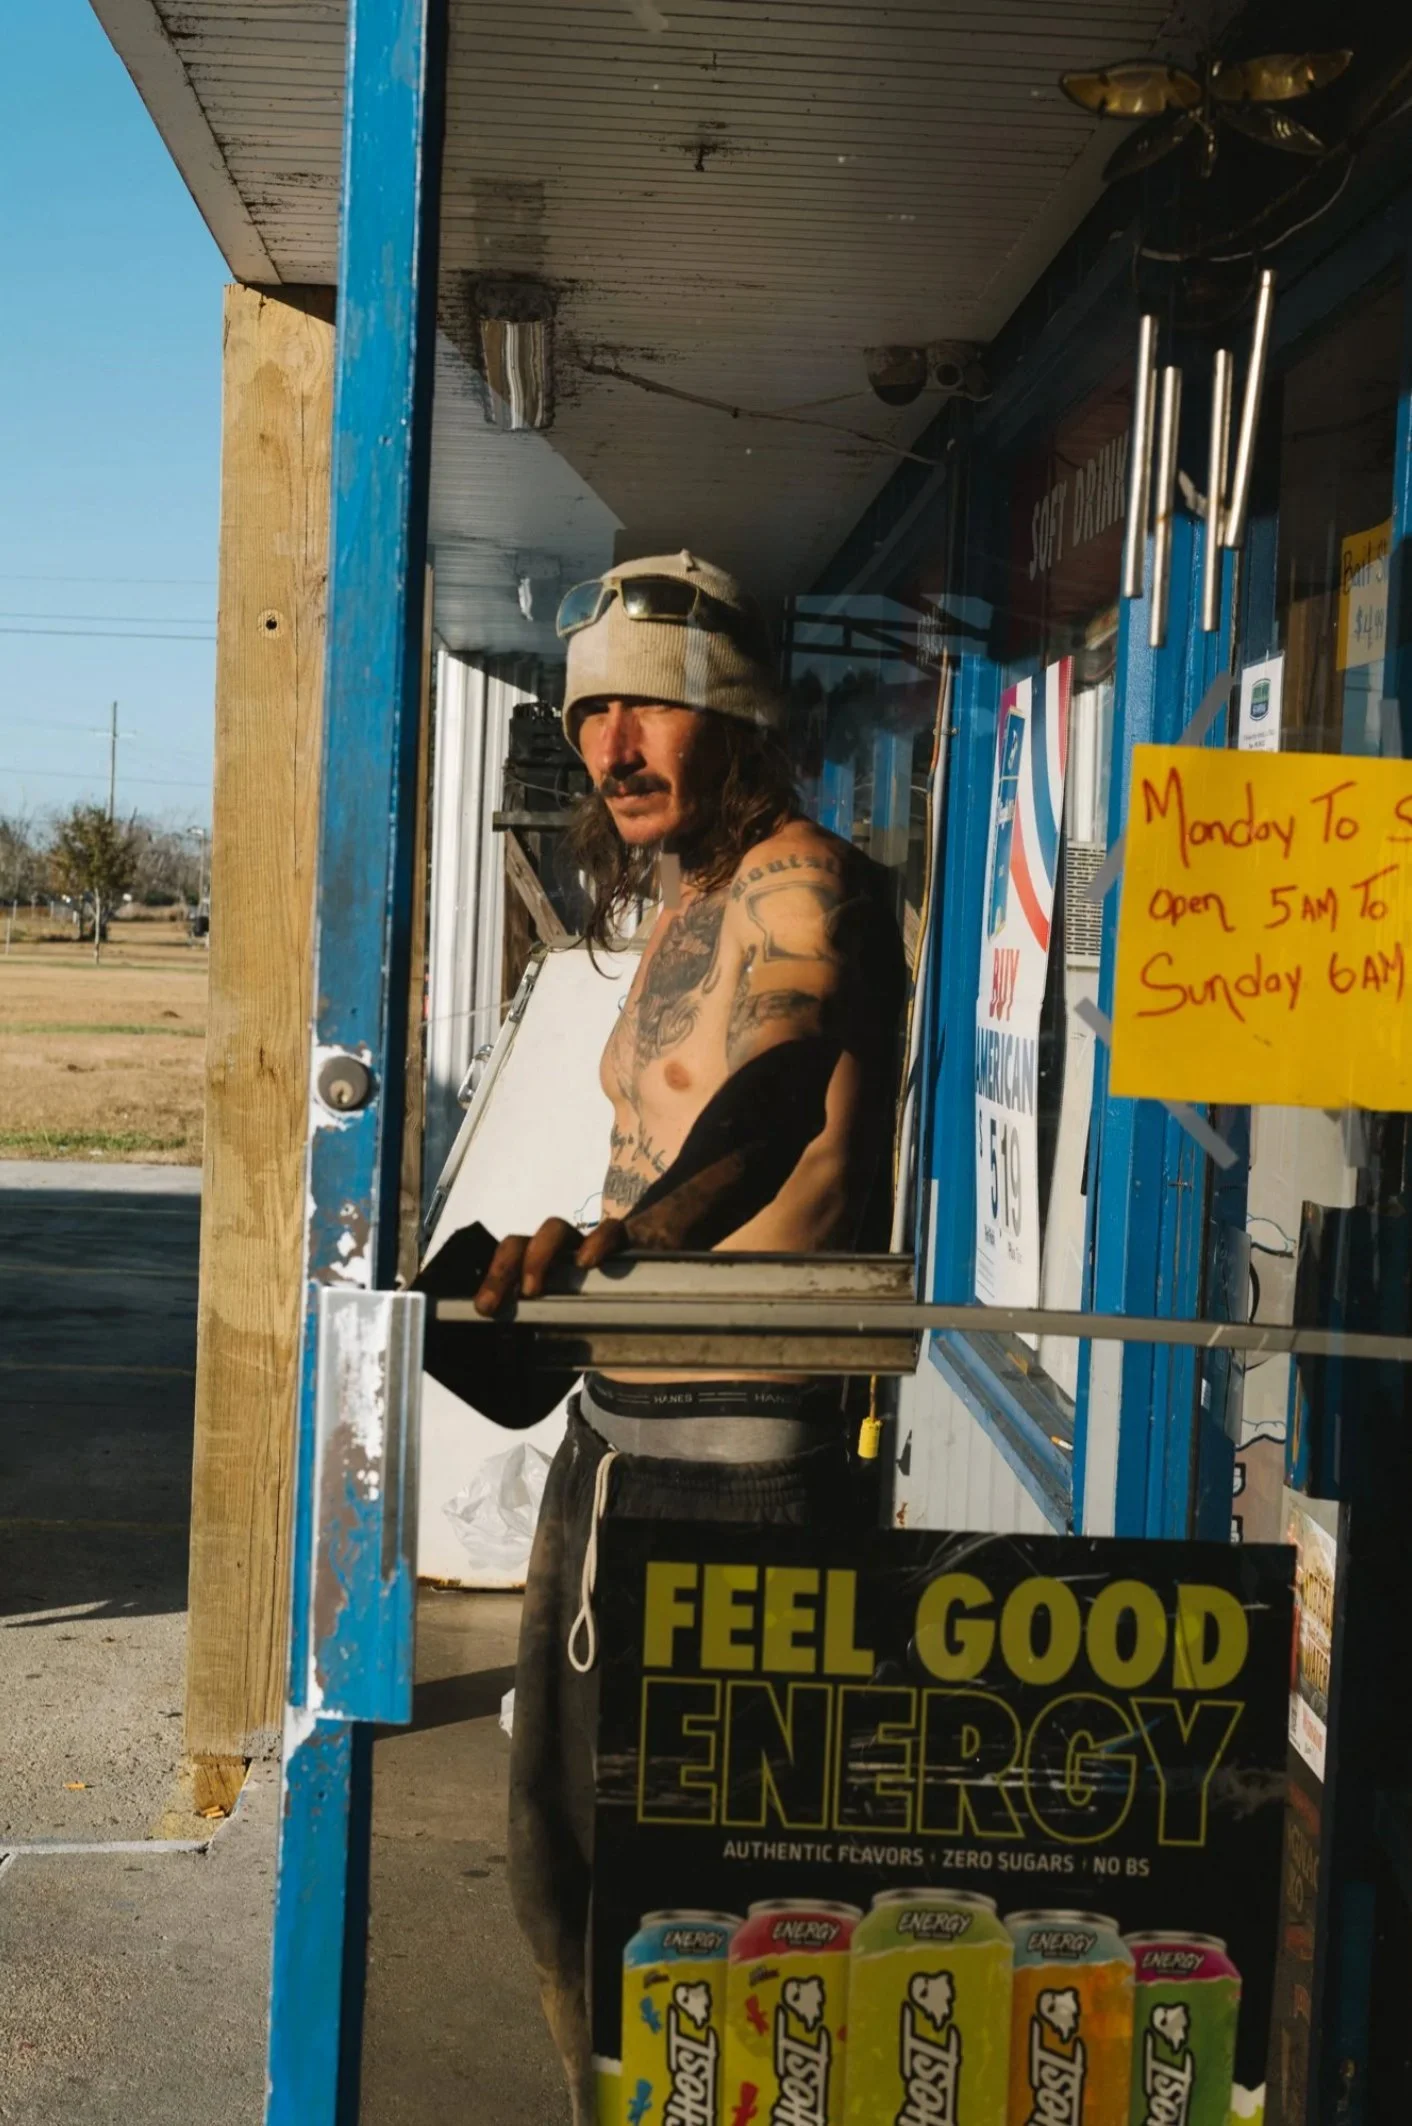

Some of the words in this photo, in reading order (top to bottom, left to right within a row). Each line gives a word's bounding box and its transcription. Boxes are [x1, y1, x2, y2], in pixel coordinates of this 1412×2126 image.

[1029, 479, 1067, 581] SOFT
[1142, 766, 1296, 868] Monday
[1311, 781, 1359, 843] To
[1386, 793, 1412, 843] S
[1350, 864, 1400, 921] To
[989, 947, 1021, 1021] BUY
[1135, 951, 1302, 1024] Sunday
[976, 1025, 1035, 1117] AMERICAN
[643, 1561, 875, 1676] FEEL
[915, 1572, 1250, 1691] GOOD
[637, 1676, 1245, 1847] ENERGY
[723, 1840, 833, 1863] AUTHENTIC
[837, 1846, 924, 1867] FLAVORS
[942, 1849, 993, 1870] ZERO
[997, 1851, 1075, 1873] SUGARS
[1093, 1855, 1120, 1875] NO
[1125, 1856, 1151, 1877] BS
[664, 1930, 723, 1949] ENERGY
[773, 1920, 840, 1941] ENERGY
[898, 1911, 971, 1934] ENERGY
[1027, 1931, 1096, 1952] ENERGY
[1141, 1950, 1205, 1972] ENERGY
[772, 2003, 830, 2126] HOST
[896, 2001, 960, 2126] HOST
